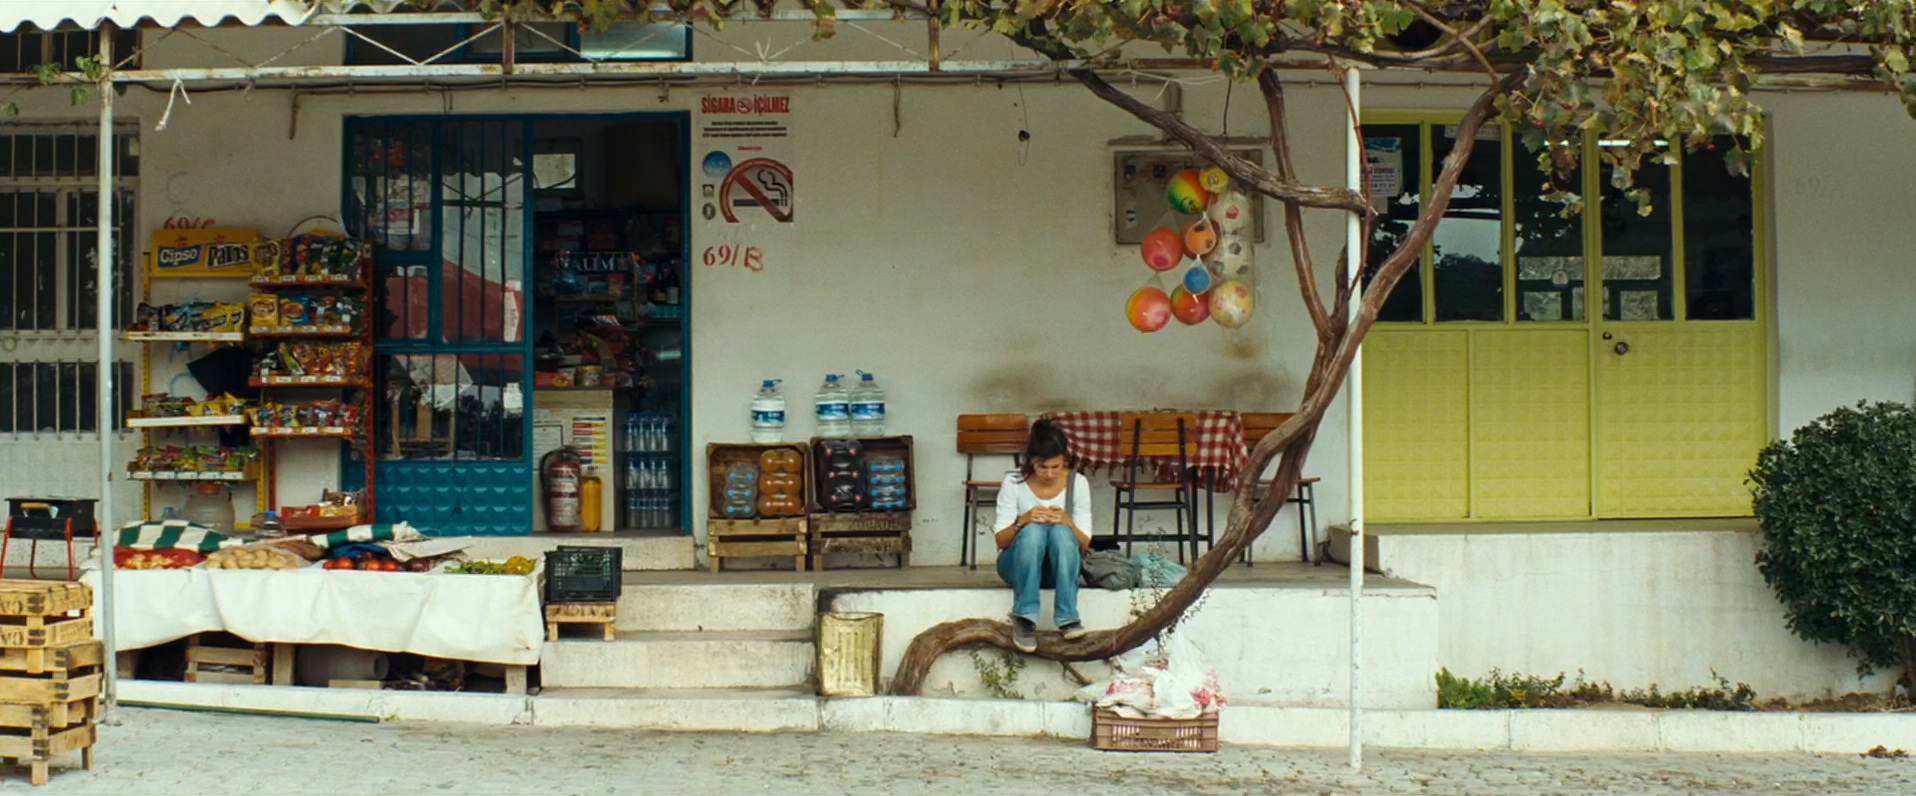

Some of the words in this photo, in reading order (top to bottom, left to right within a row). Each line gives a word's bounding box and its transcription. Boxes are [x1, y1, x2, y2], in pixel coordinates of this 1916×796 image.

[701, 94, 736, 114] SİGARA
[754, 94, 790, 116] İÇİLMEZ
[159, 248, 199, 266] Cipso
[702, 243, 764, 272] 69/B
